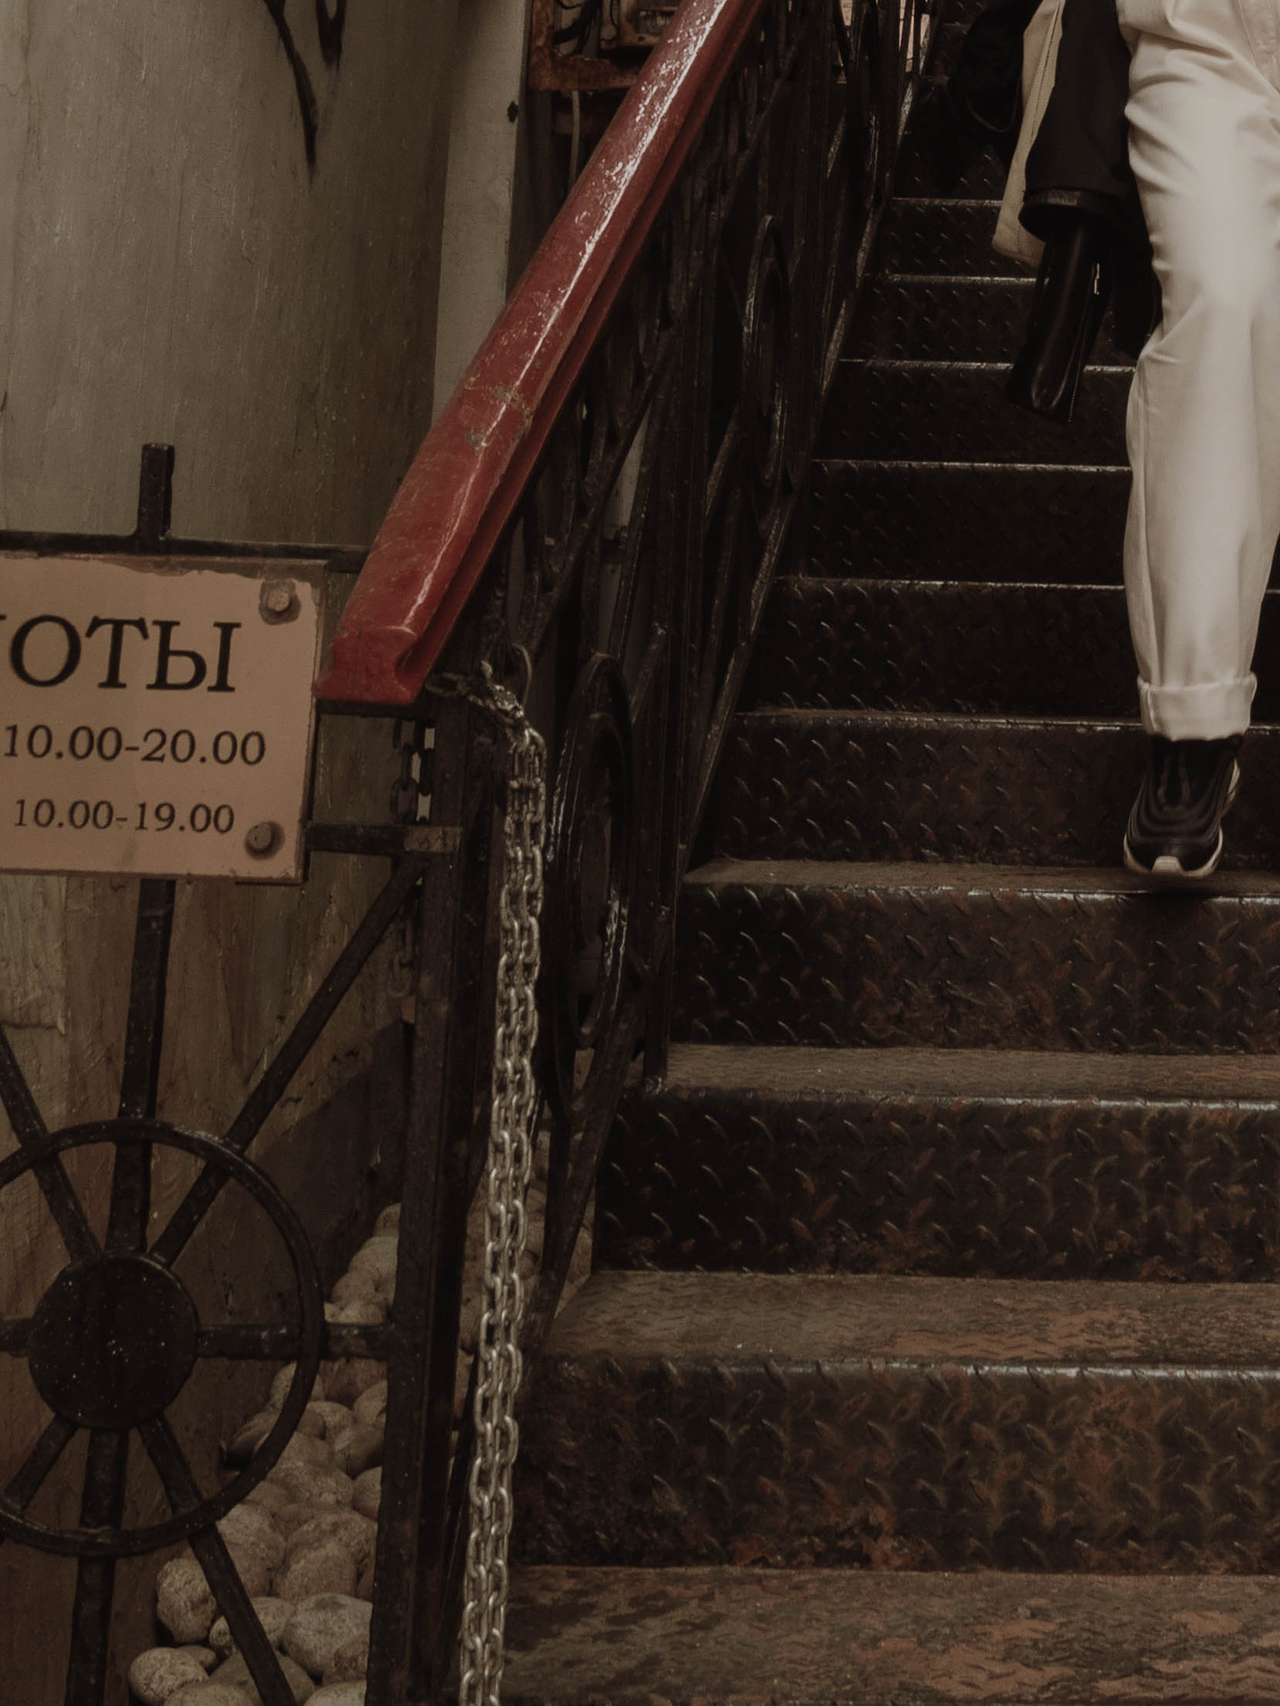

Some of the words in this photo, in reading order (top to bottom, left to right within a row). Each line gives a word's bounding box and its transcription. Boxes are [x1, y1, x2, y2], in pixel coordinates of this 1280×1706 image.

[0, 614, 242, 693] ОТЫ
[3, 723, 267, 766] 10.00-20.00
[13, 798, 236, 834] 10.00-19.00
